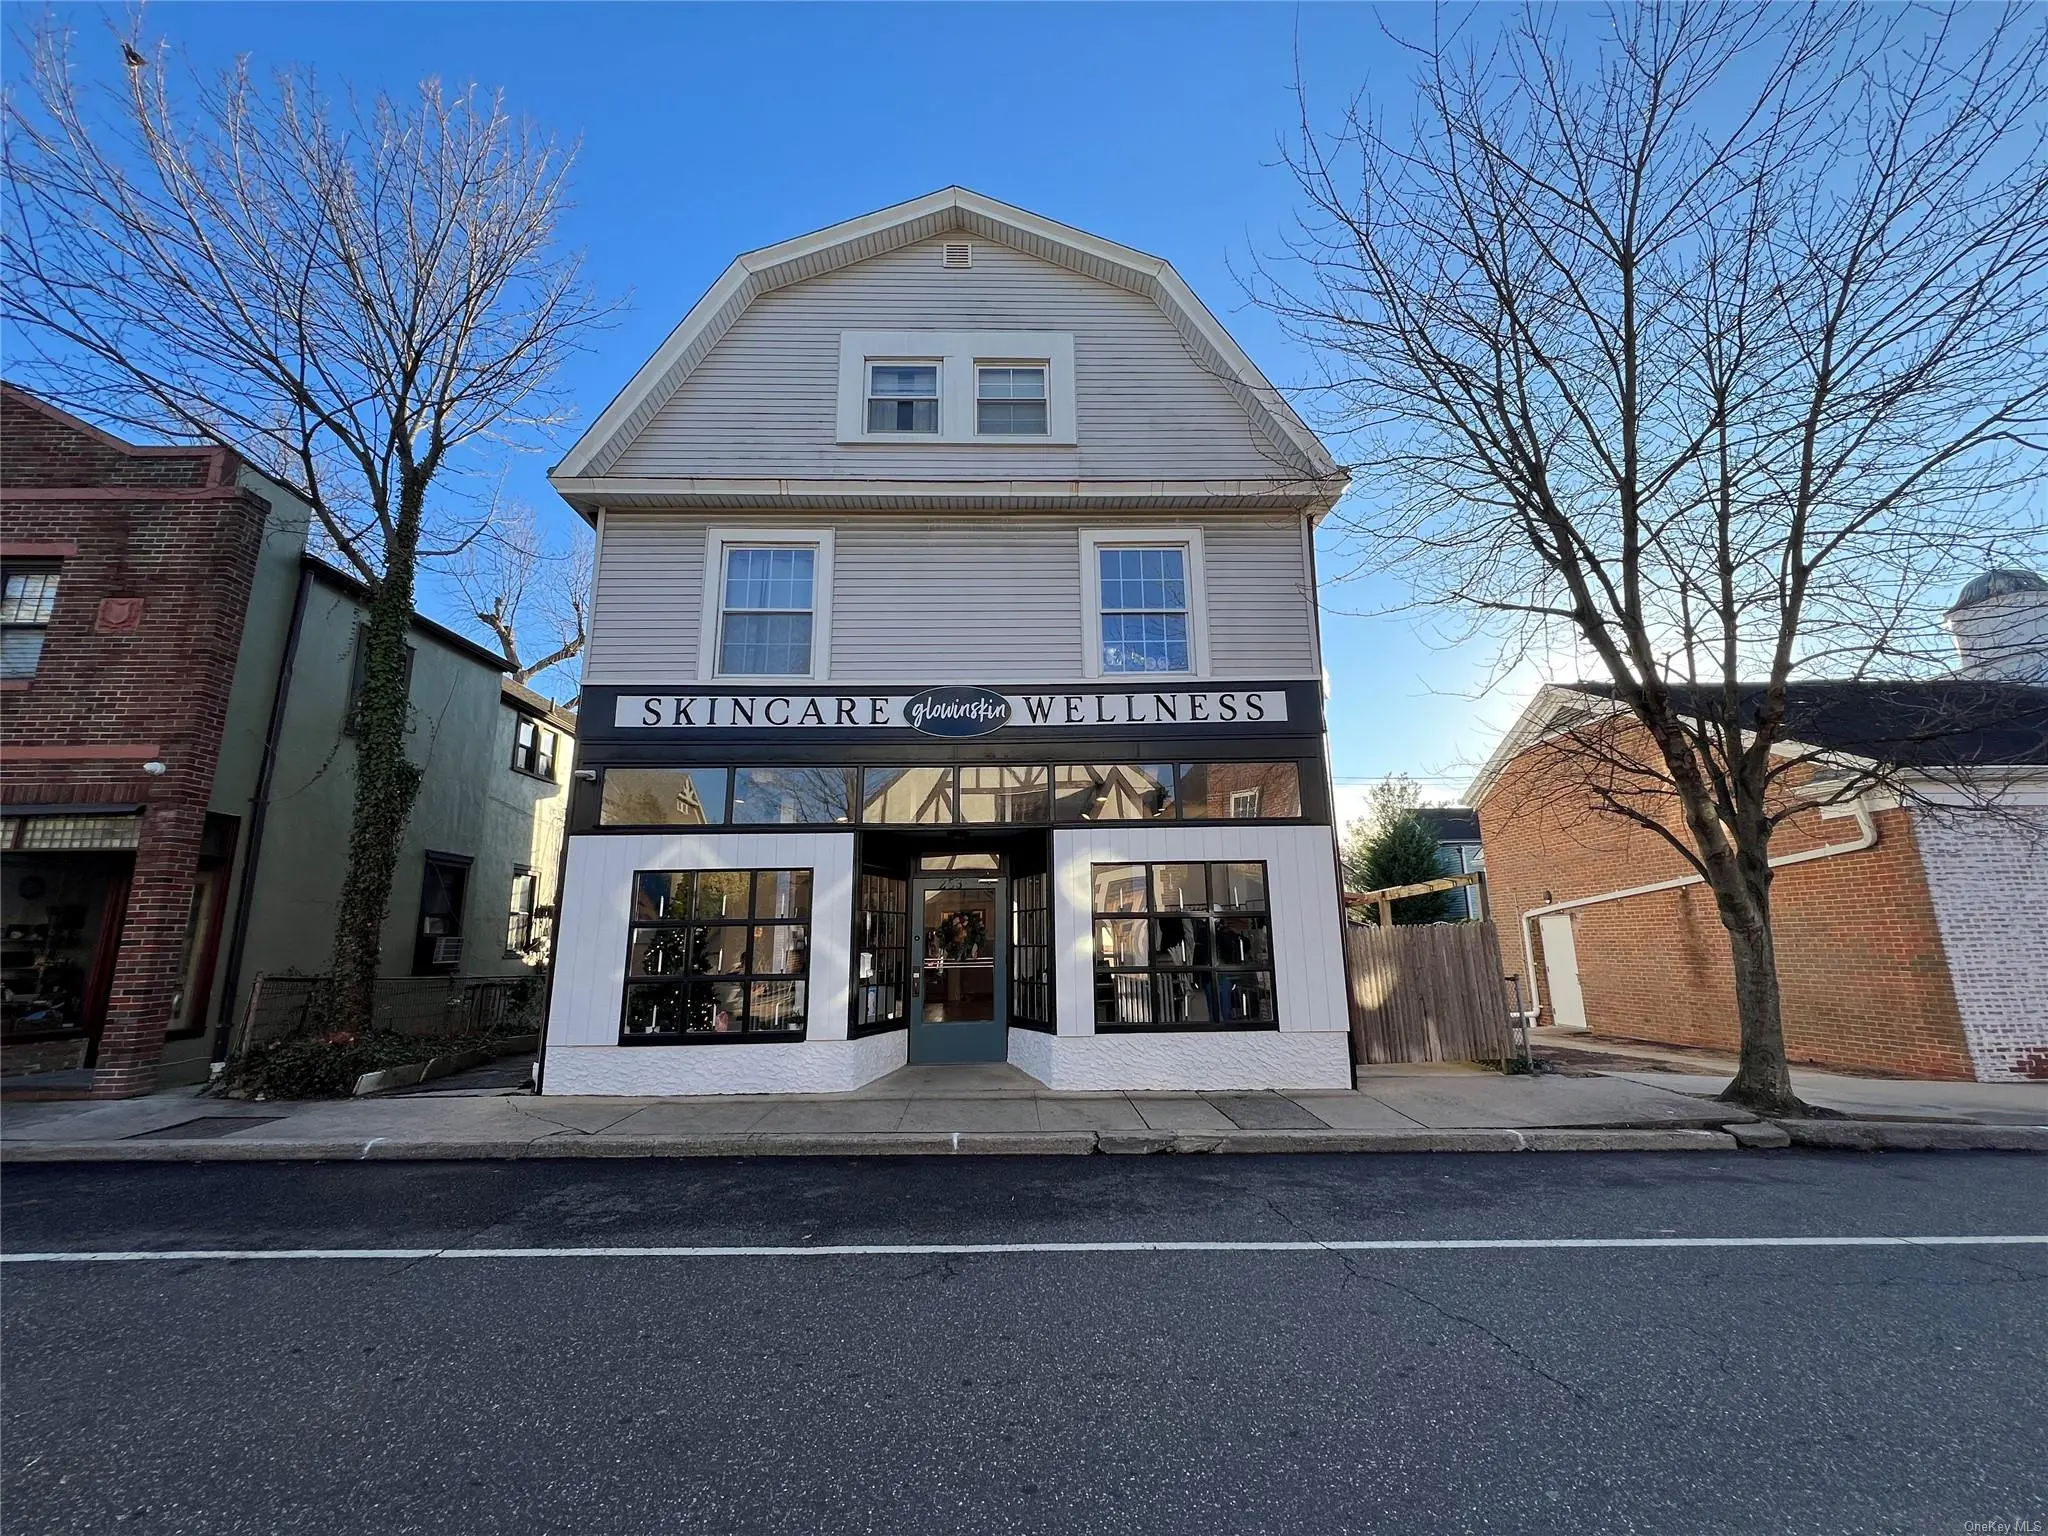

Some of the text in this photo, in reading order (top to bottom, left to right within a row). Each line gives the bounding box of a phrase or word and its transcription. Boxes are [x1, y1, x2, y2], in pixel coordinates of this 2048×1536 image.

[642, 697, 890, 726] SKINCARE
[911, 696, 1006, 727] glowinskin
[1022, 693, 1265, 724] WELLNESS
